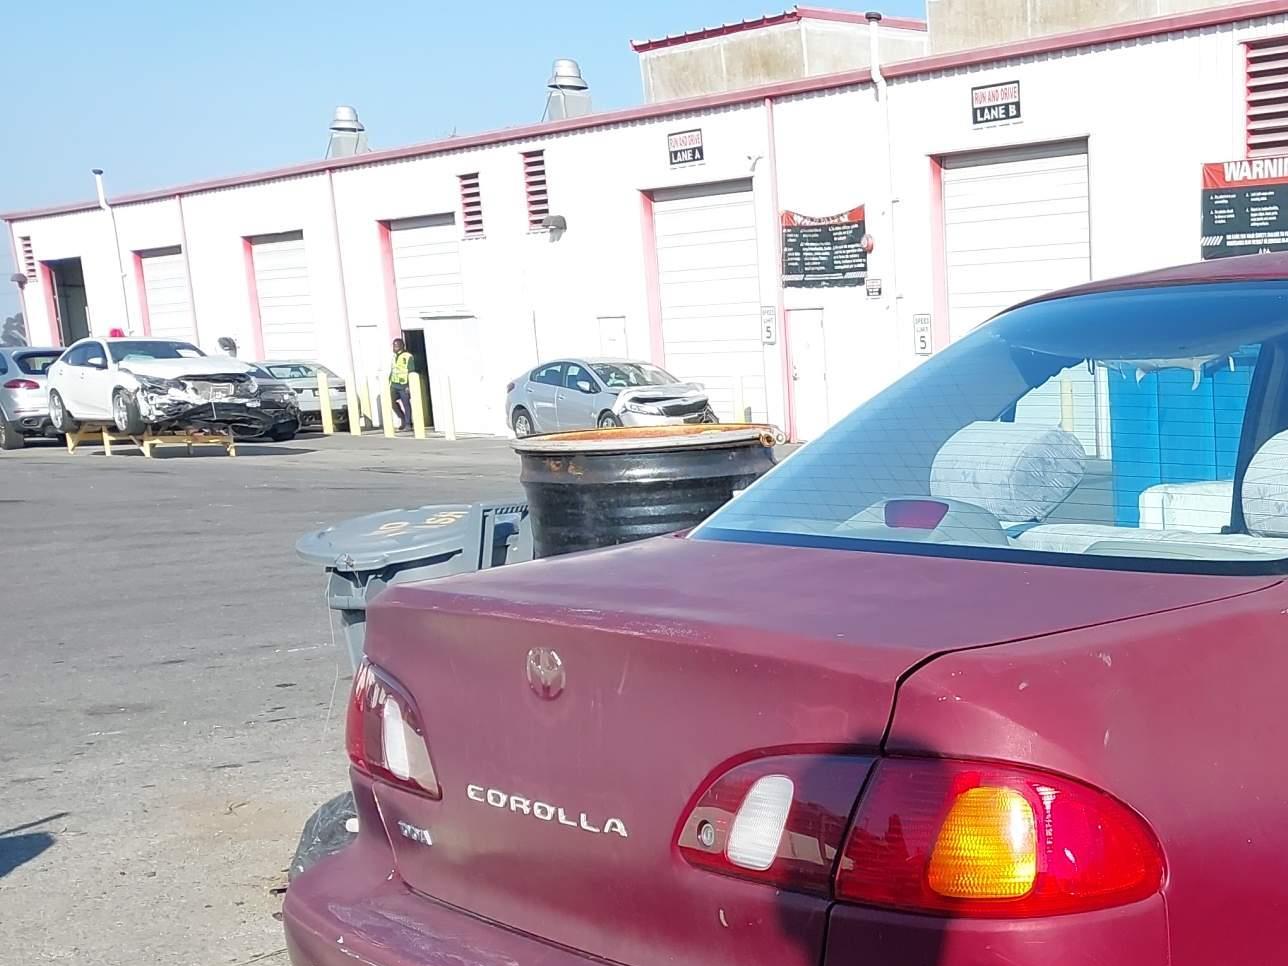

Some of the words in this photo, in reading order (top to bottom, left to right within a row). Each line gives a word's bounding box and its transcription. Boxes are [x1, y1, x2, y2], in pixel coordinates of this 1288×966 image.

[976, 105, 1006, 122] LANE
[1008, 104, 1017, 117] B
[671, 150, 693, 162] LANE
[694, 148, 701, 160] A
[766, 326, 772, 339] 5
[919, 335, 927, 350] 5
[466, 783, 629, 838] COROLLA
